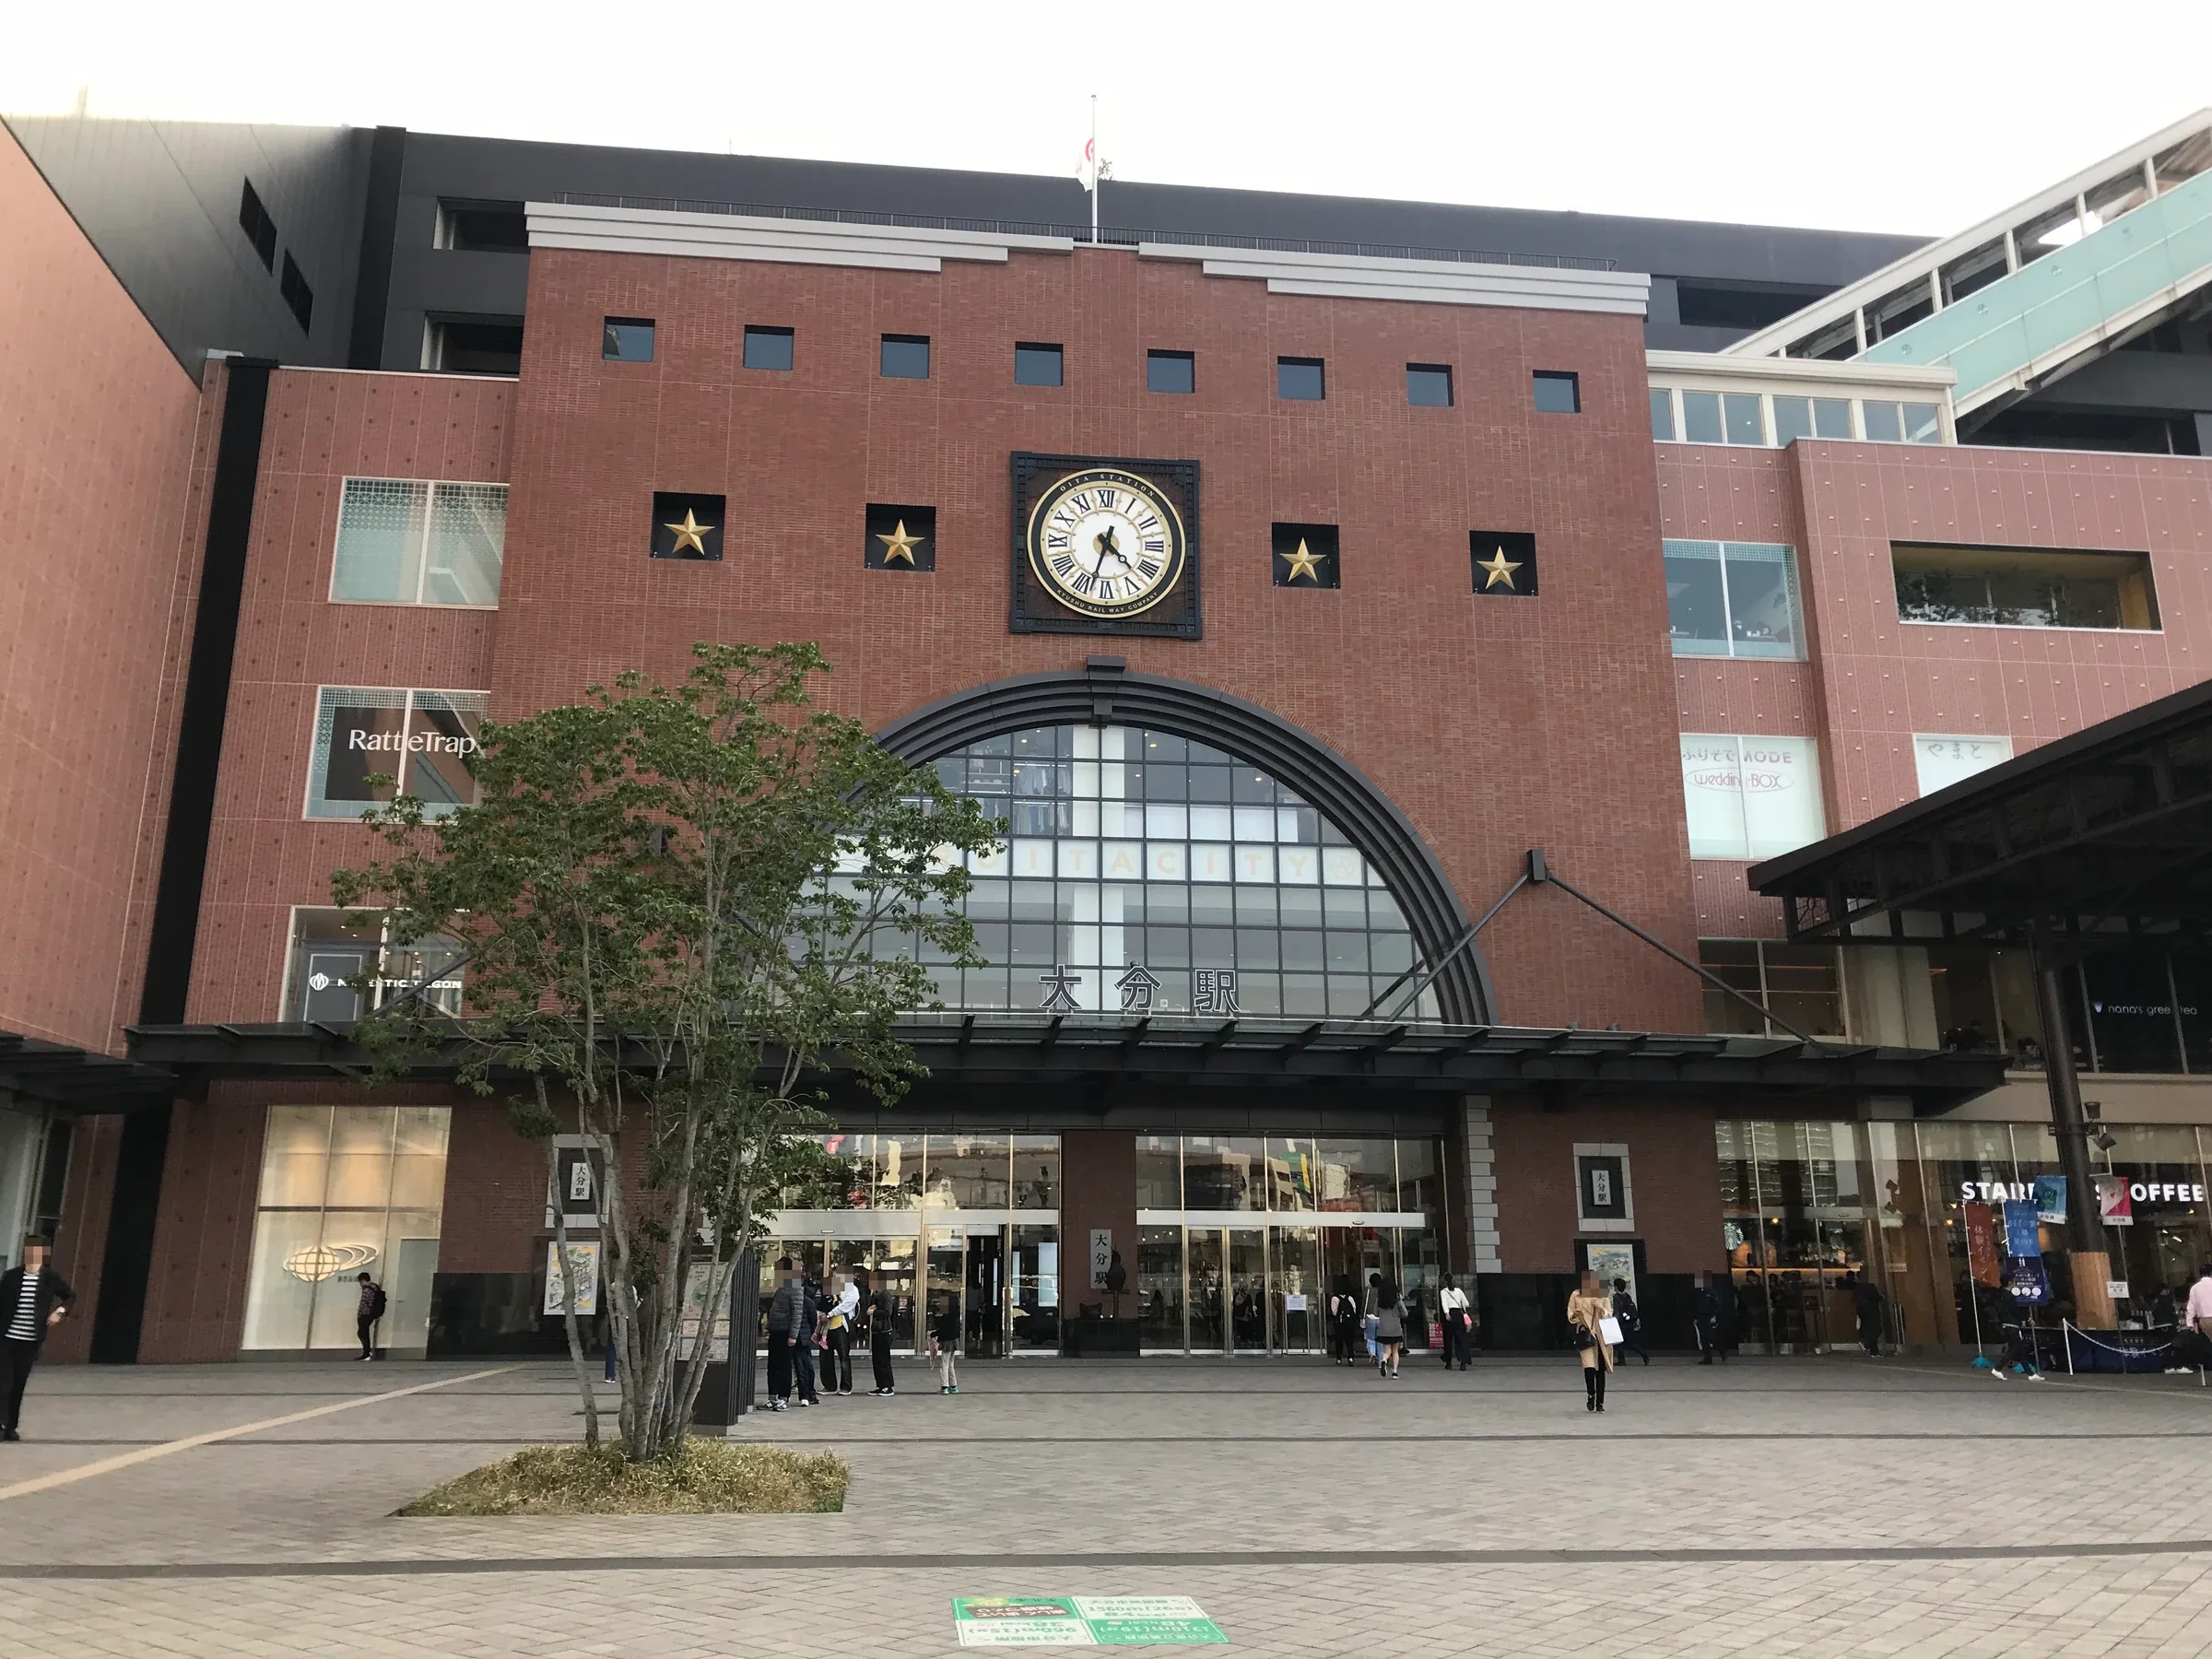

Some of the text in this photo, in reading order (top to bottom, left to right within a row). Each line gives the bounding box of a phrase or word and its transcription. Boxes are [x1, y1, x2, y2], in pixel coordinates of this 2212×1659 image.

[1060, 474, 1155, 497] OITA STATION
[1057, 589, 1085, 608] KYUSHU
[1127, 592, 1158, 610] COMPANY
[348, 729, 476, 759] RatteTrap
[1927, 741, 1983, 759] やまと
[1039, 964, 1241, 1012] 大分駅
[2108, 1006, 2143, 1014] nana's
[2147, 1006, 2171, 1016] gree
[574, 1165, 586, 1197] 大分駅
[1597, 1172, 1607, 1202] 大分駅
[2130, 1182, 2204, 1202] OFFEE
[1094, 1233, 1108, 1284] 大分駅
